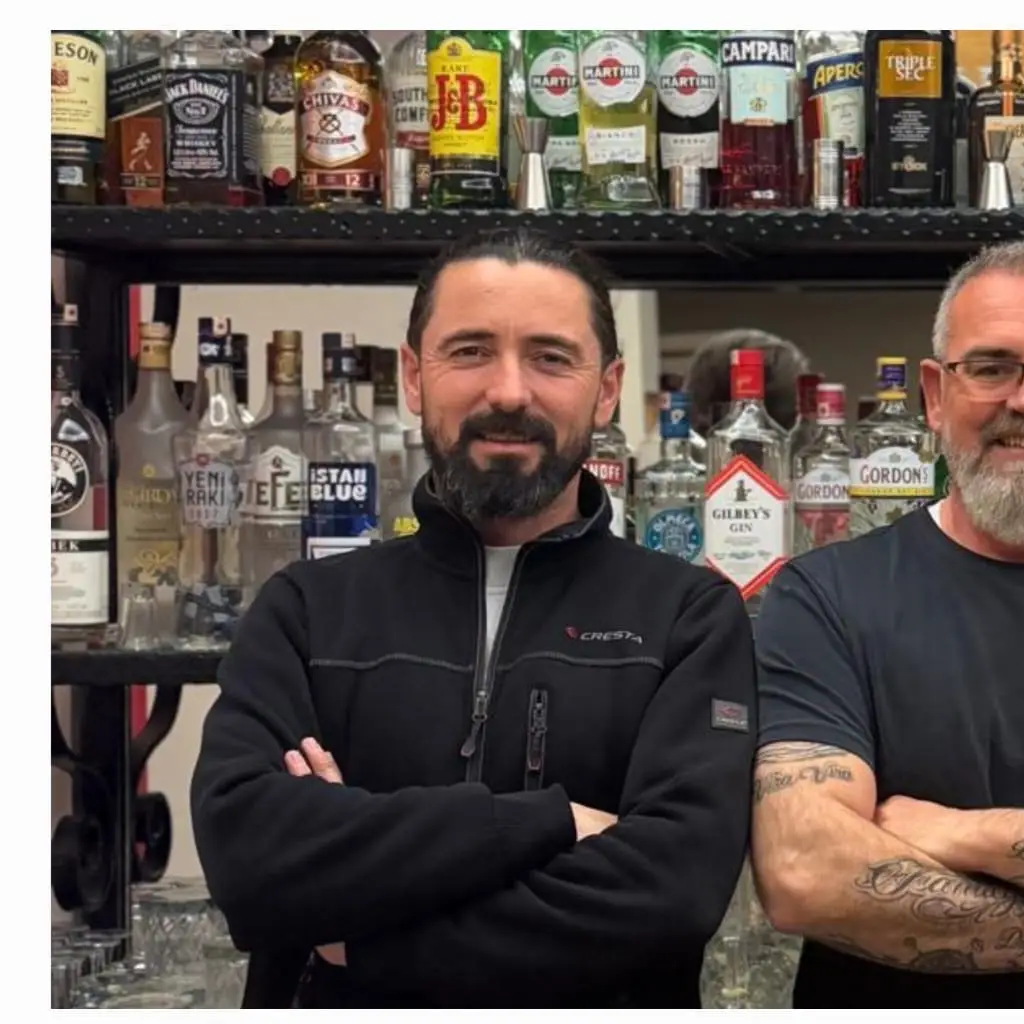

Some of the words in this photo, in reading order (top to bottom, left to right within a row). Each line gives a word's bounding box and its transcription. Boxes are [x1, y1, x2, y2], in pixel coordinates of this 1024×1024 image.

[722, 38, 794, 62] CAMPARI
[887, 54, 936, 70] TRIPLE
[583, 65, 641, 79] MARTINI
[896, 69, 924, 81] SEC
[660, 74, 716, 89] MARTINI
[303, 92, 361, 111] CHIVAS
[431, 74, 487, 131] J&B
[860, 465, 928, 484] GORDON'S
[712, 507, 771, 521] GILBEY'S
[729, 523, 754, 534] GIN
